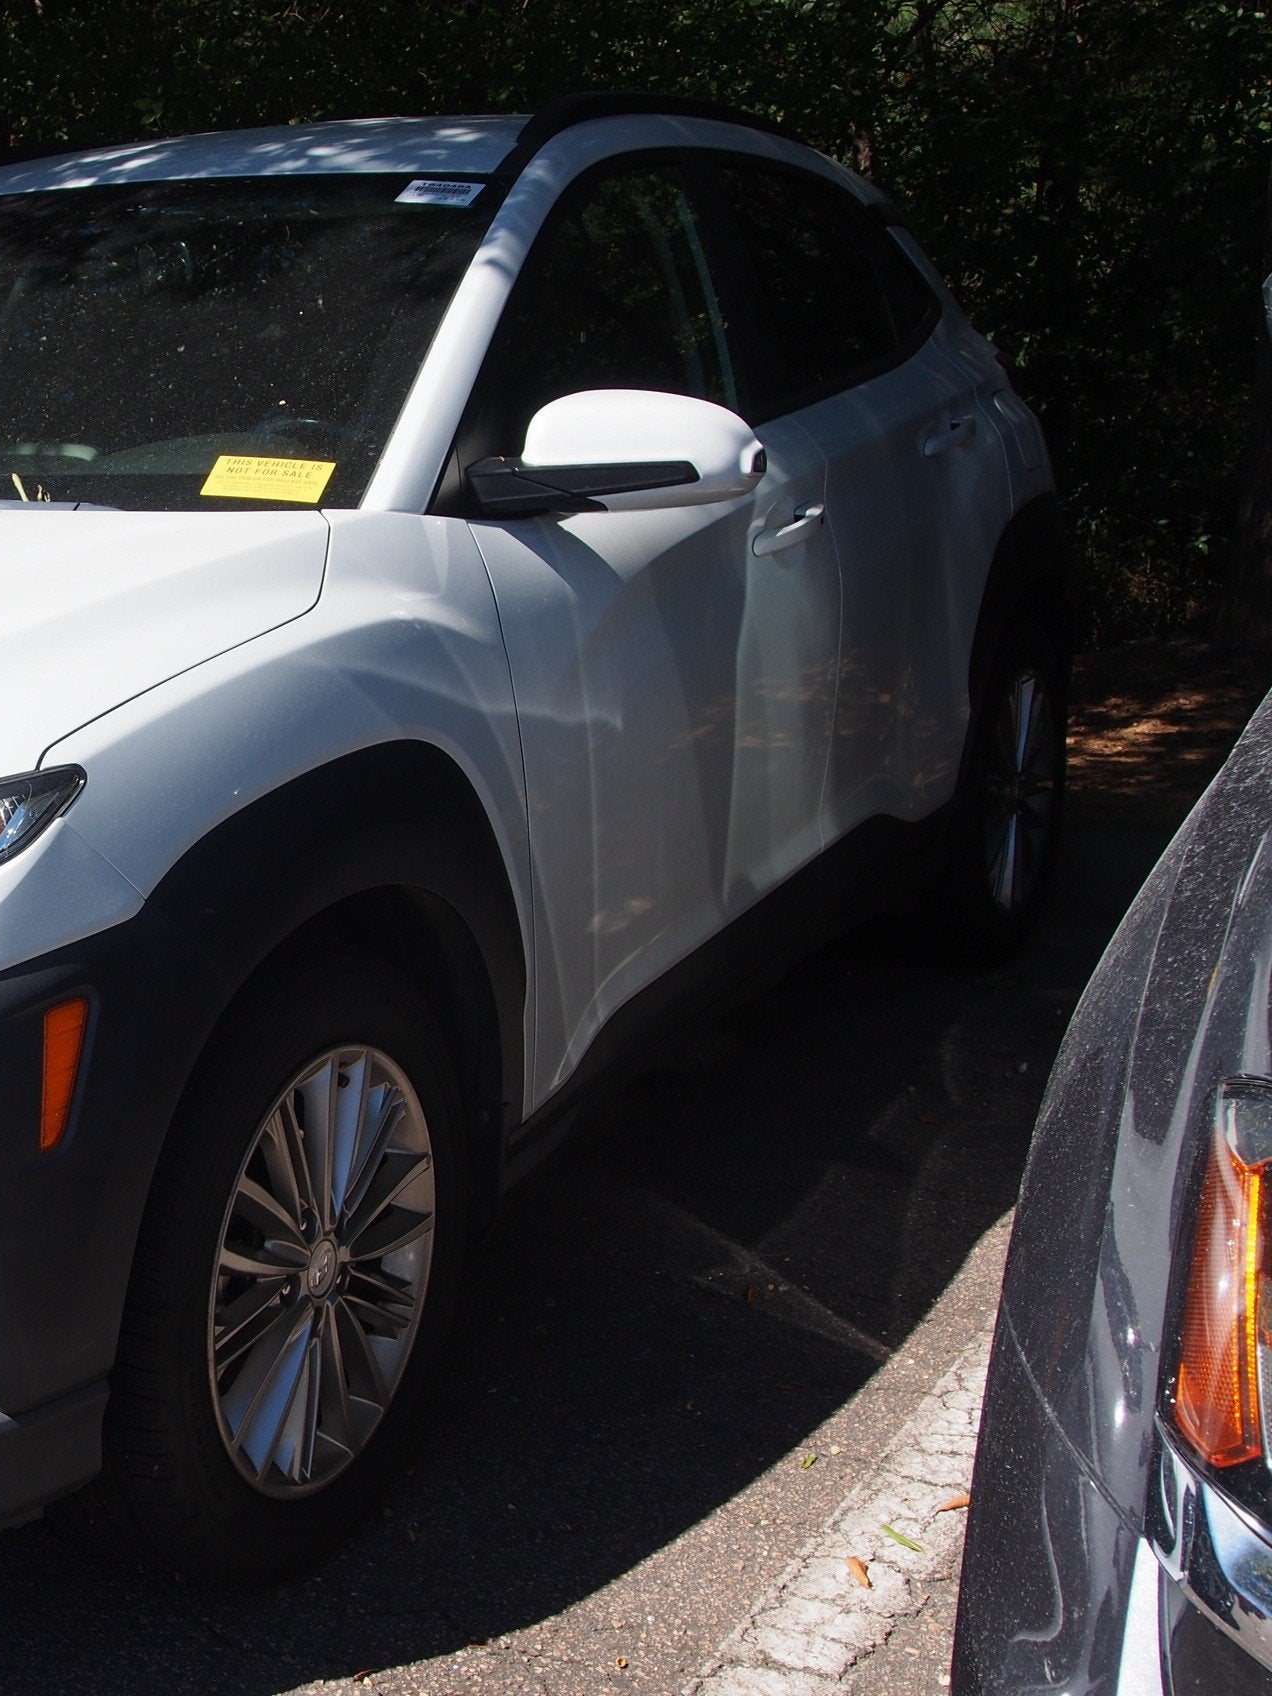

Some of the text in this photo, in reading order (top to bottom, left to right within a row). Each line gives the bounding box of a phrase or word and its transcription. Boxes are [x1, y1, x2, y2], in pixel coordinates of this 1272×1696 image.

[226, 459, 252, 467] THIS
[257, 461, 305, 470] VEHICLE
[225, 467, 313, 479] NOT FOR SALE
